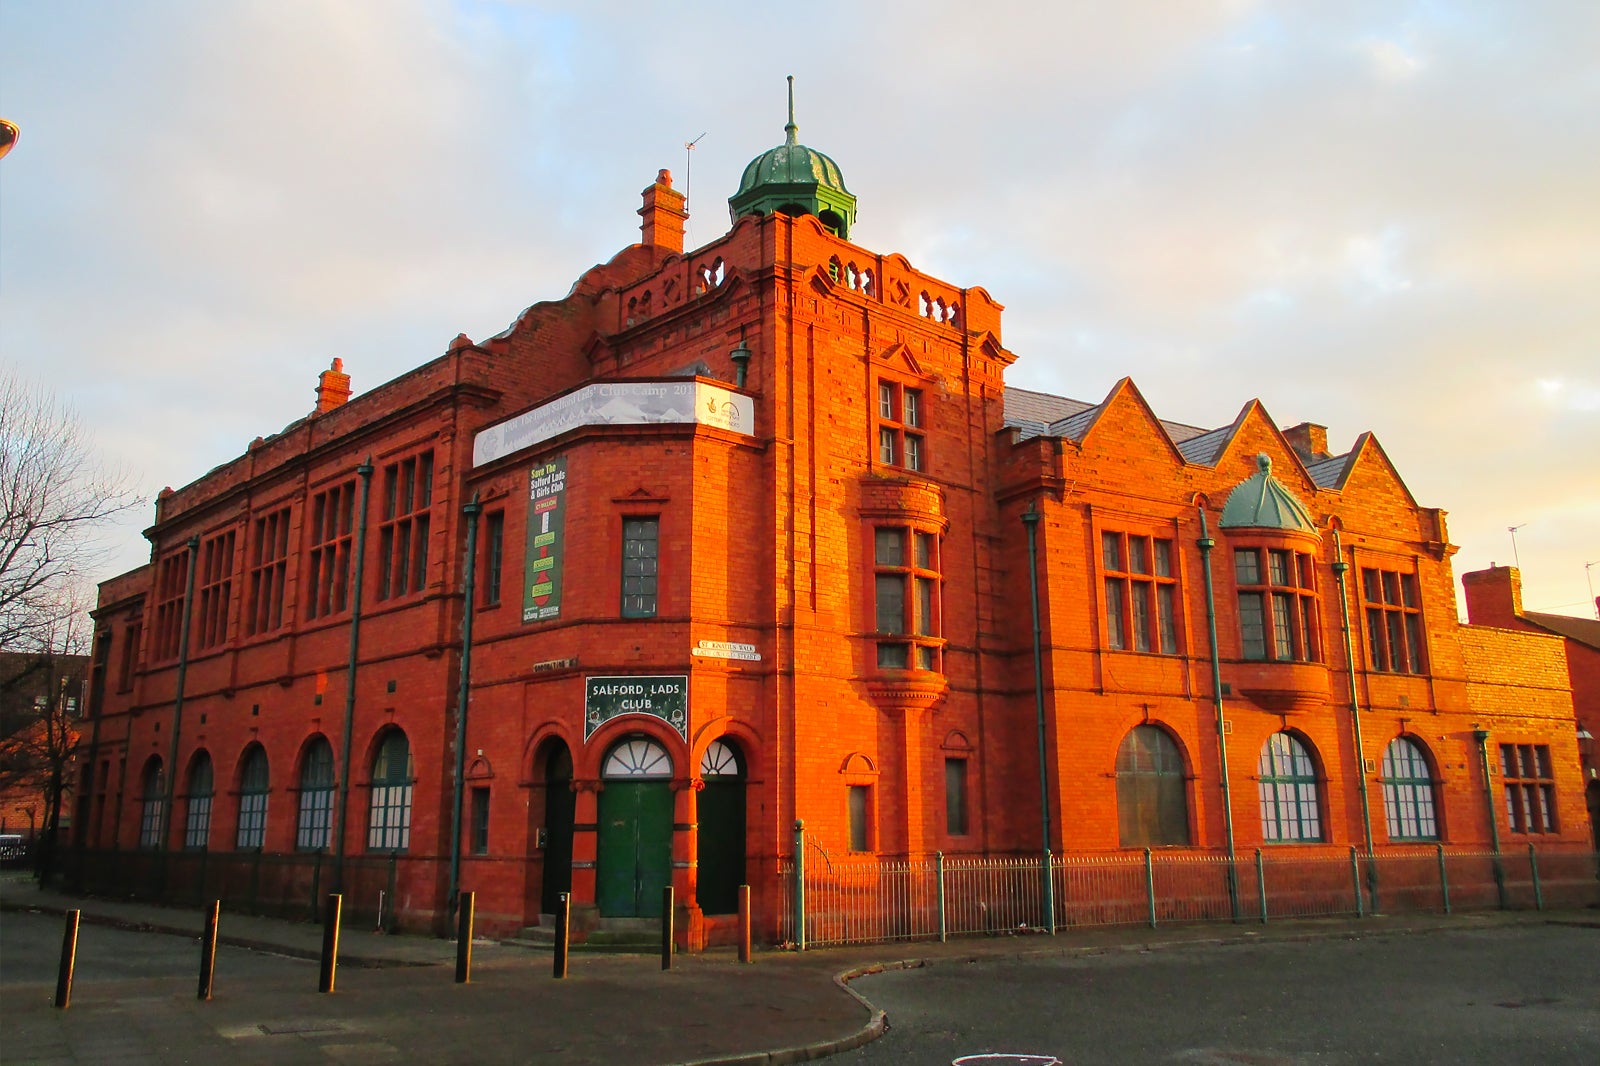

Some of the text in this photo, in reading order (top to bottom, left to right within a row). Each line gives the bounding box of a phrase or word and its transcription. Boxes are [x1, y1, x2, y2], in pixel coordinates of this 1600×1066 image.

[599, 385, 628, 397] Club
[632, 385, 667, 398] Camp
[531, 463, 557, 479] Save The
[531, 470, 566, 489] Salford Lads
[536, 486, 550, 498] Girls
[551, 481, 564, 493] Club
[593, 684, 680, 696] SALFORD LADS
[621, 698, 652, 710] CLUB
